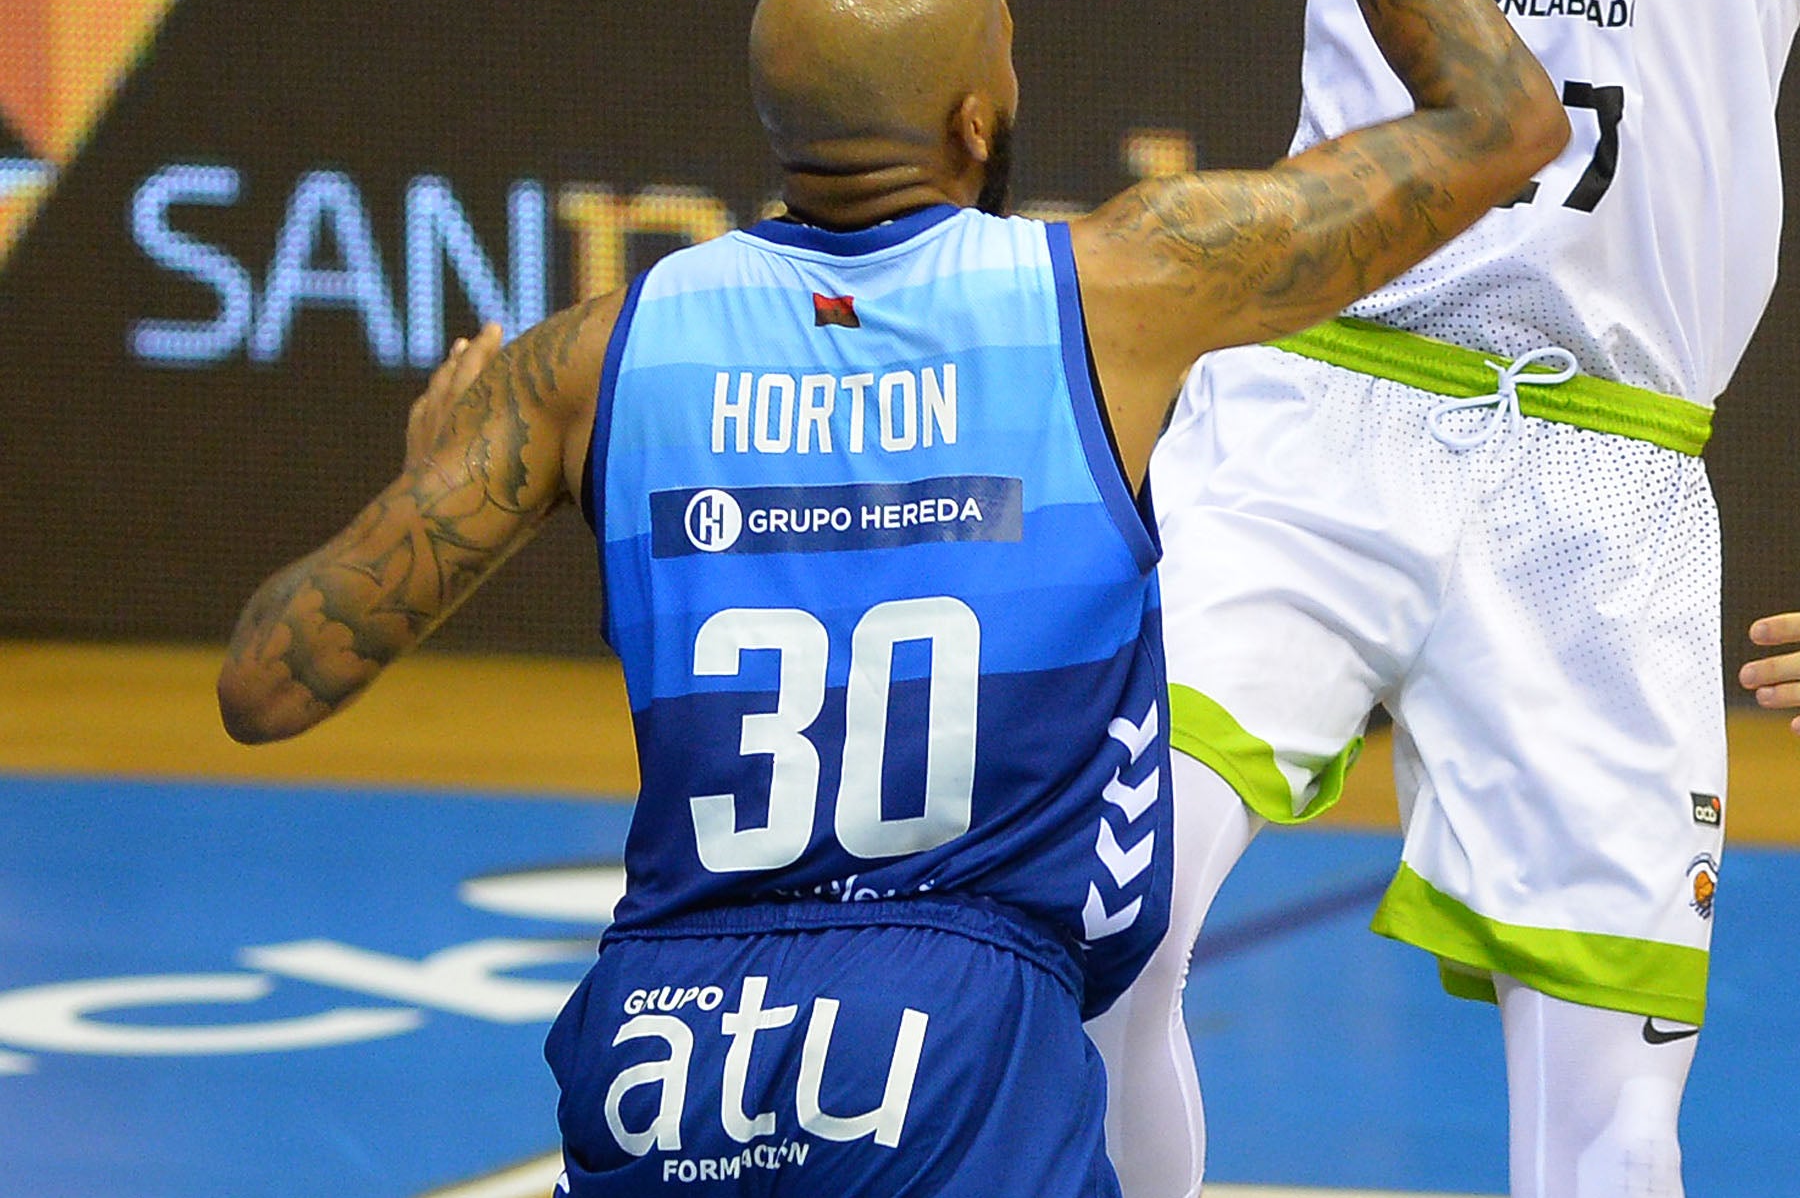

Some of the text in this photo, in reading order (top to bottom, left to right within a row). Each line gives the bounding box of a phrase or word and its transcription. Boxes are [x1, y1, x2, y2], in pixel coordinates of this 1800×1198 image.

[711, 363, 958, 454] HORTON
[748, 507, 852, 534] GRUPO
[860, 497, 984, 531] HEREDA
[689, 595, 982, 873] 30
[623, 985, 724, 1015] GRUPO
[604, 975, 930, 1157] atu
